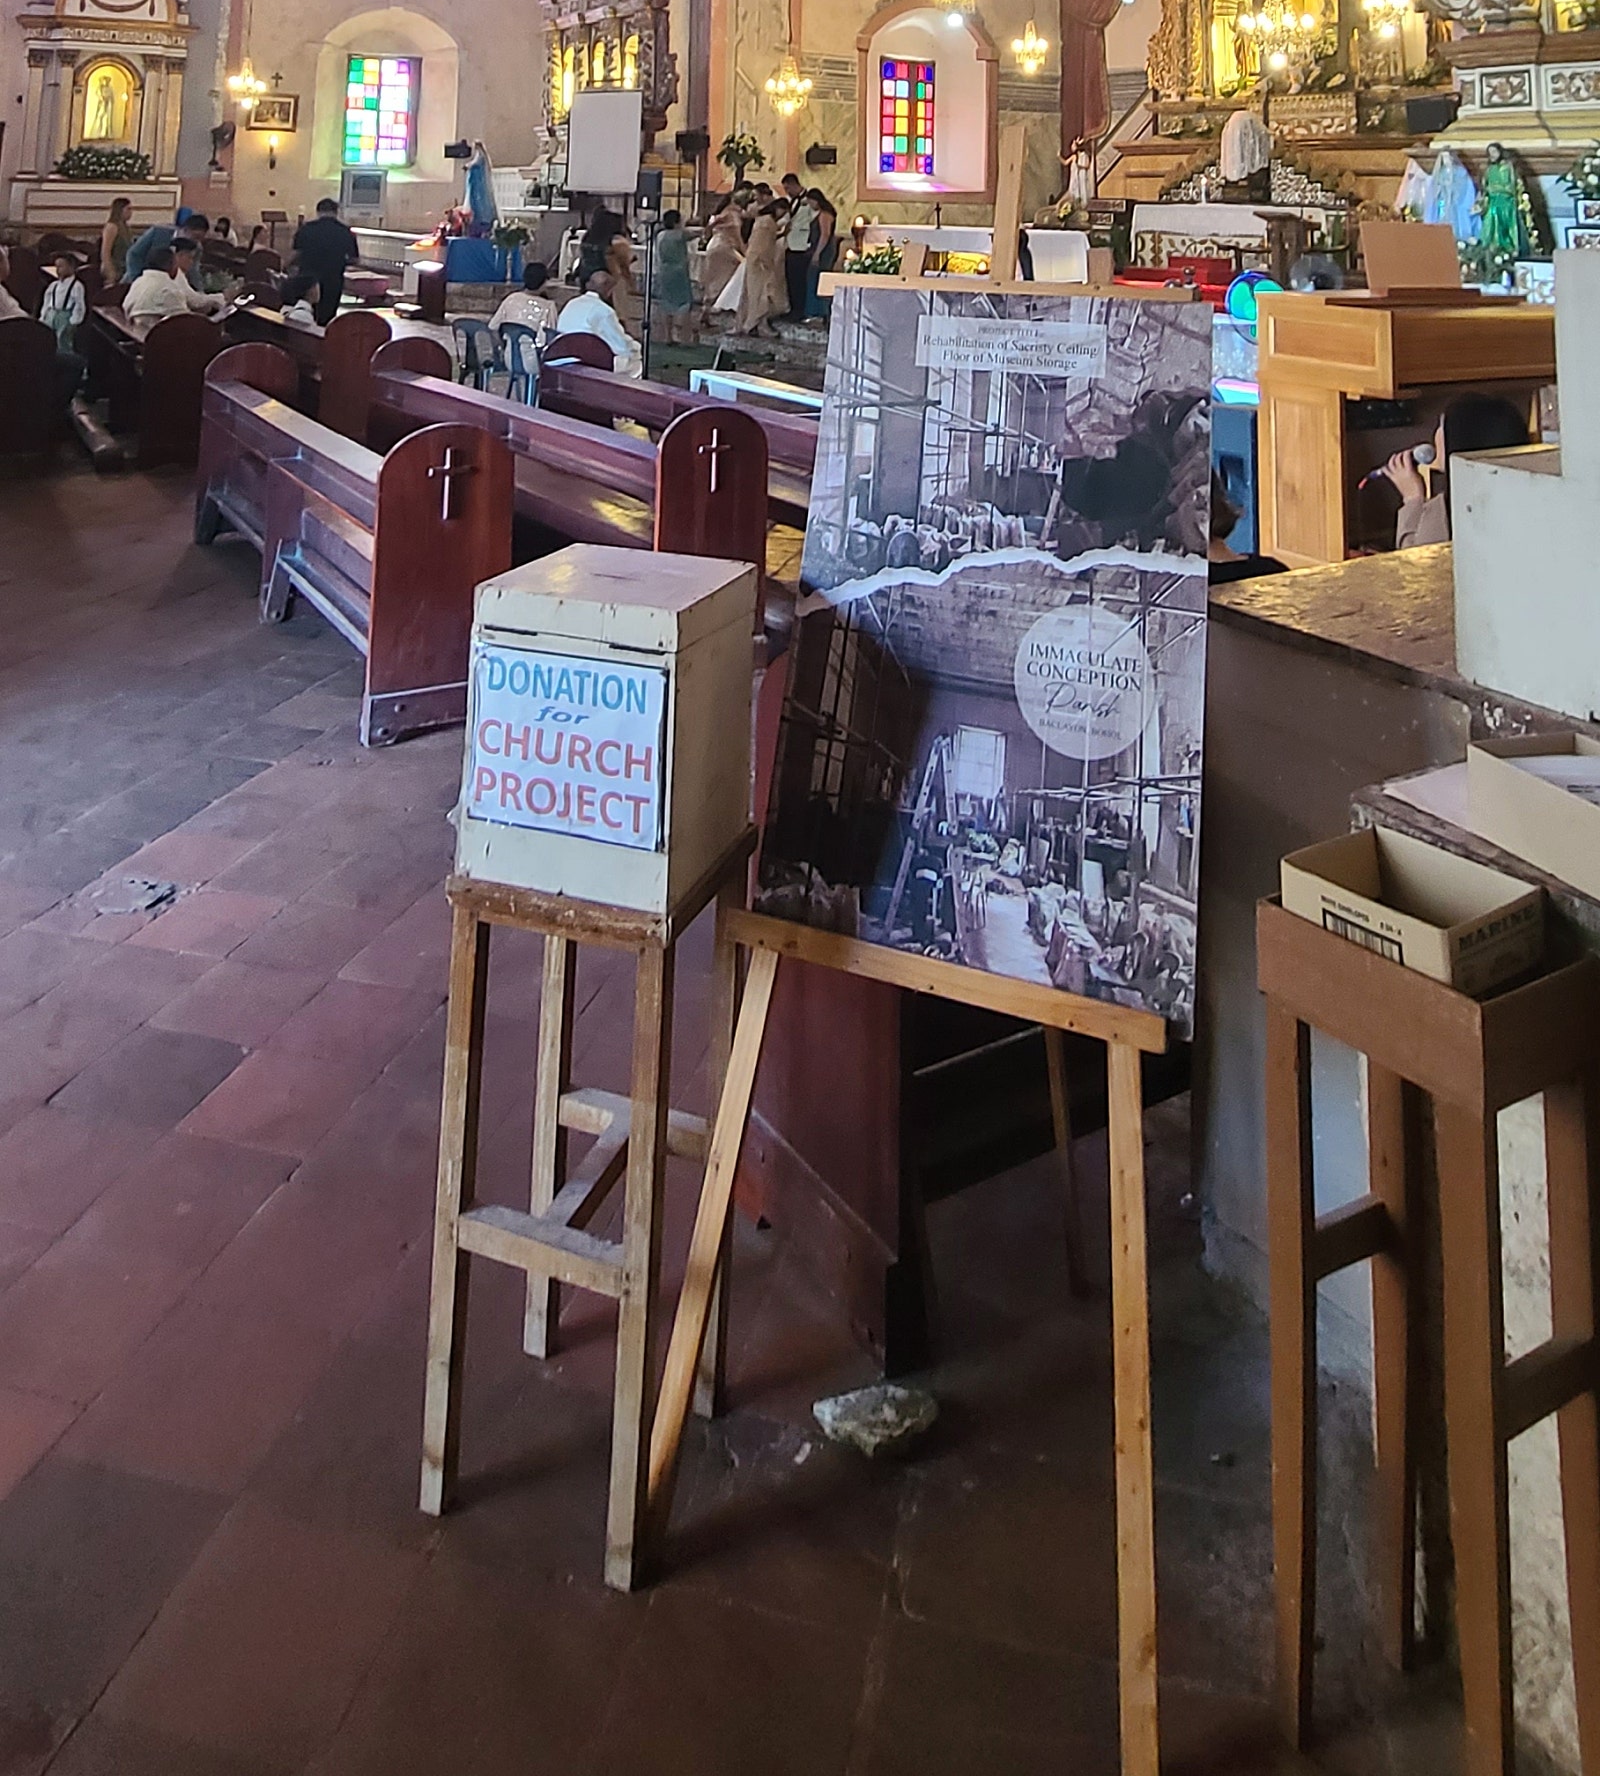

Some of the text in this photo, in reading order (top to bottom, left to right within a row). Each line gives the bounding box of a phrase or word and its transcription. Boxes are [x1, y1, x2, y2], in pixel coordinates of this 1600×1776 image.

[923, 335, 994, 350] Rehabilitation
[997, 340, 1010, 350] of
[1011, 340, 1053, 354] Sacristy
[943, 350, 1077, 371] Floor of Museum Storage
[1030, 643, 1141, 673] IMMACULATE
[487, 656, 648, 714] DONATION
[1027, 661, 1142, 691] CONCEPTION
[1044, 681, 1121, 719] Parish
[534, 706, 590, 725] for
[478, 719, 653, 782] CHURCH
[474, 766, 650, 834] PROJECT
